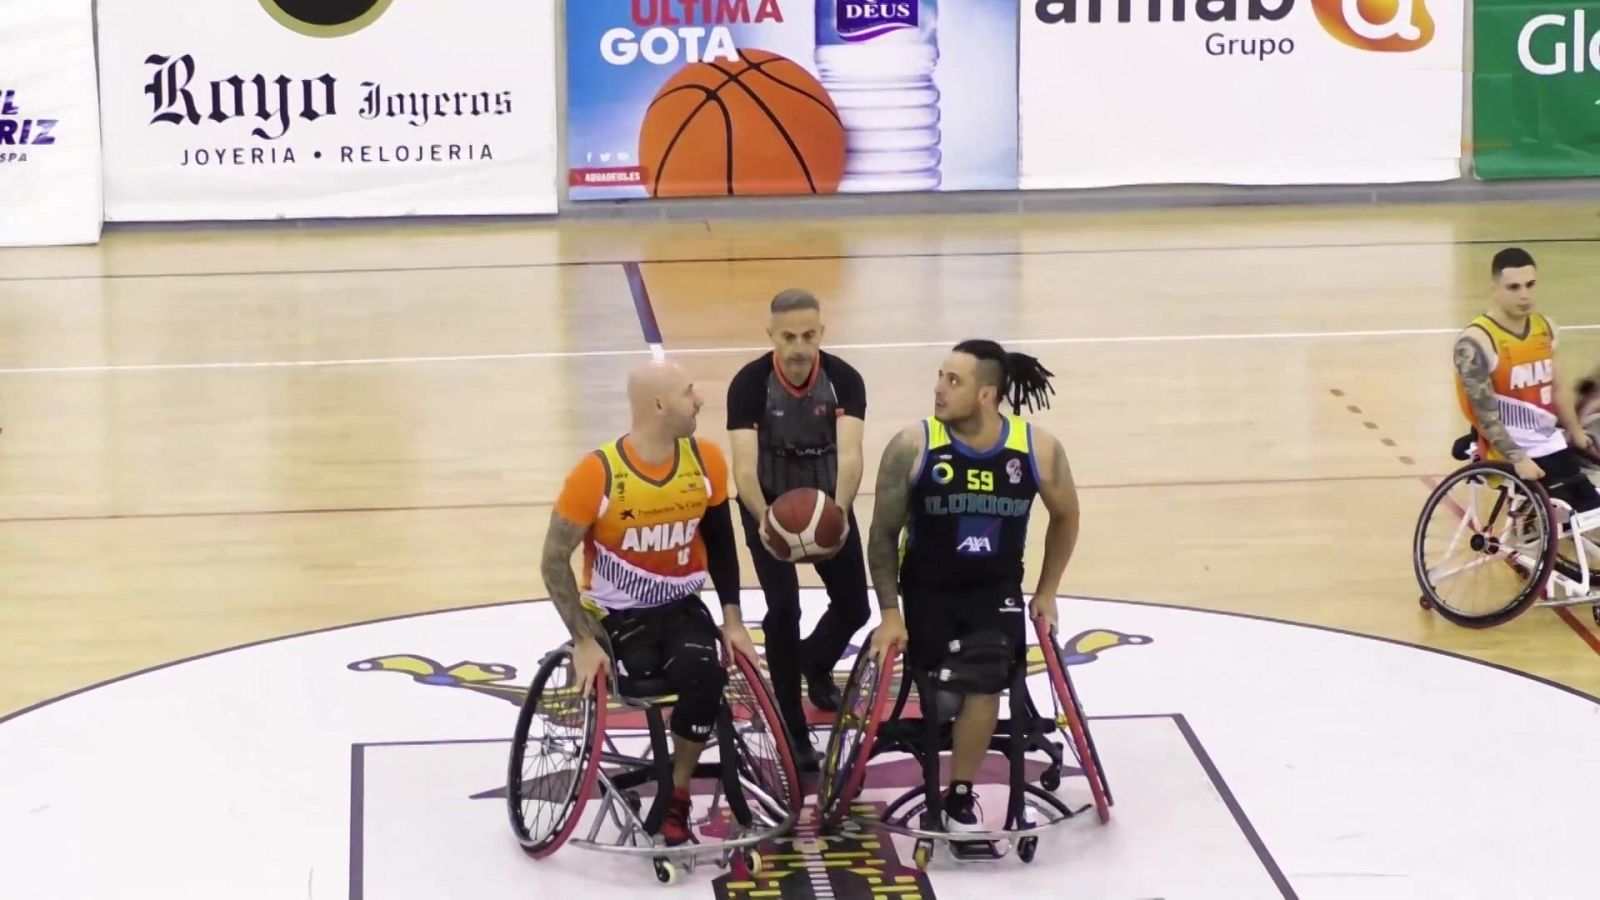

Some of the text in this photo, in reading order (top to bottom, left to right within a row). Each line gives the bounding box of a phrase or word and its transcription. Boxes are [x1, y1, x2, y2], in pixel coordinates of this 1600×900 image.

[845, 3, 910, 19] DEUS
[600, 27, 740, 65] GOTA
[1205, 33, 1295, 61] Grupo
[1518, 9, 1600, 75] Gl
[144, 54, 512, 140] Royo Joyeros
[181, 144, 494, 166] JOYERIA RELOJERIA
[967, 469, 994, 491] 59
[925, 493, 1029, 517] ILUNION
[956, 536, 992, 552] AXA
